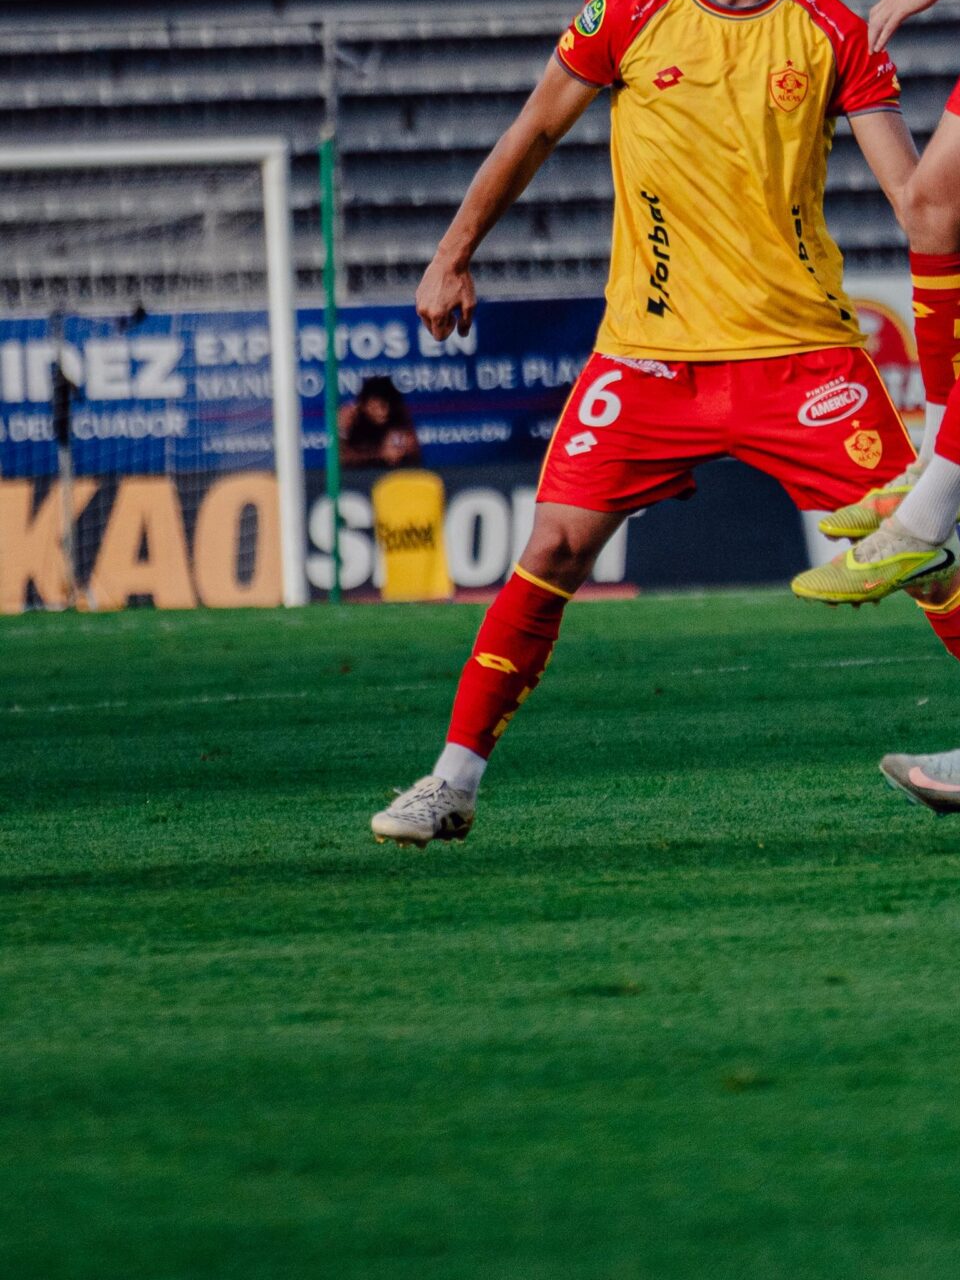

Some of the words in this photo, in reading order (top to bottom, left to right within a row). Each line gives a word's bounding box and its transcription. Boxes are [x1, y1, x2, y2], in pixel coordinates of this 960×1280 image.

[195, 322, 409, 366] EXPRTOS
[578, 370, 623, 427] 6
[805, 376, 845, 399] PINTURAS
[810, 391, 860, 420] AMERICA
[0, 472, 288, 613] KAO
